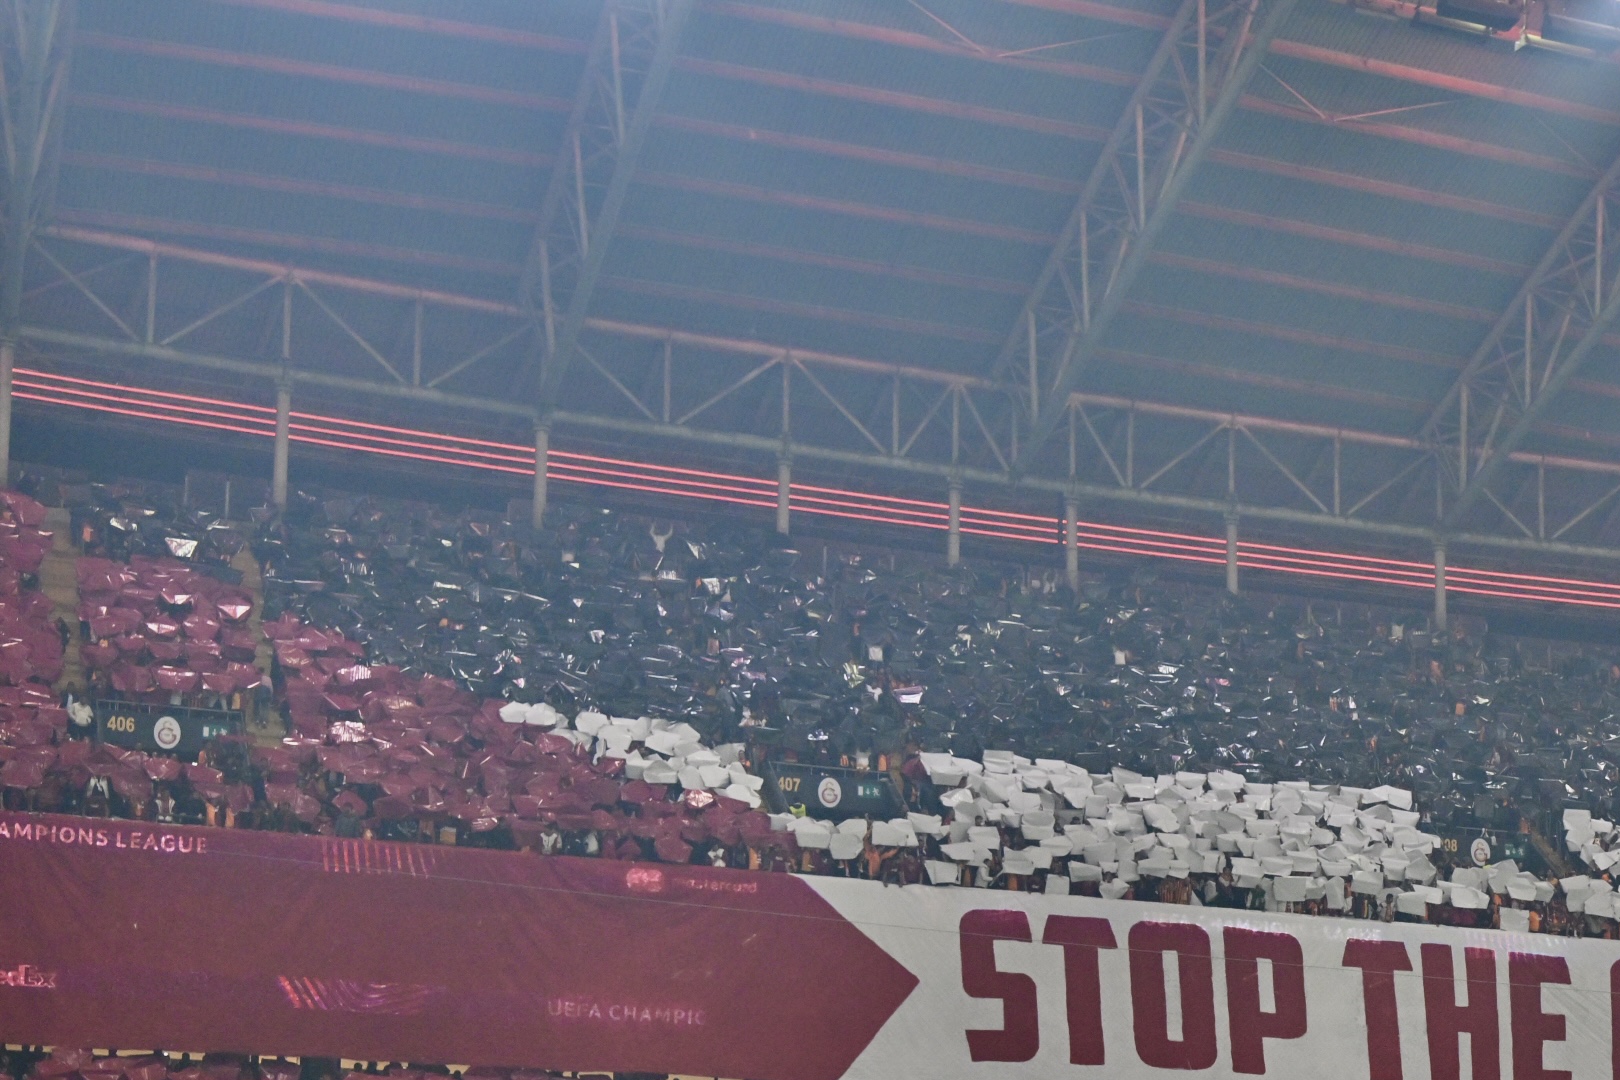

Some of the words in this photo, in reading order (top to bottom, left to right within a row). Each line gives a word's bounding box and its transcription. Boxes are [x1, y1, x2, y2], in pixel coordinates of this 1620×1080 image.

[107, 715, 135, 733] 406
[778, 776, 801, 793] 407
[115, 832, 208, 854] LEAGUE
[1441, 838, 1458, 852] 08
[959, 908, 1308, 1076] STOP
